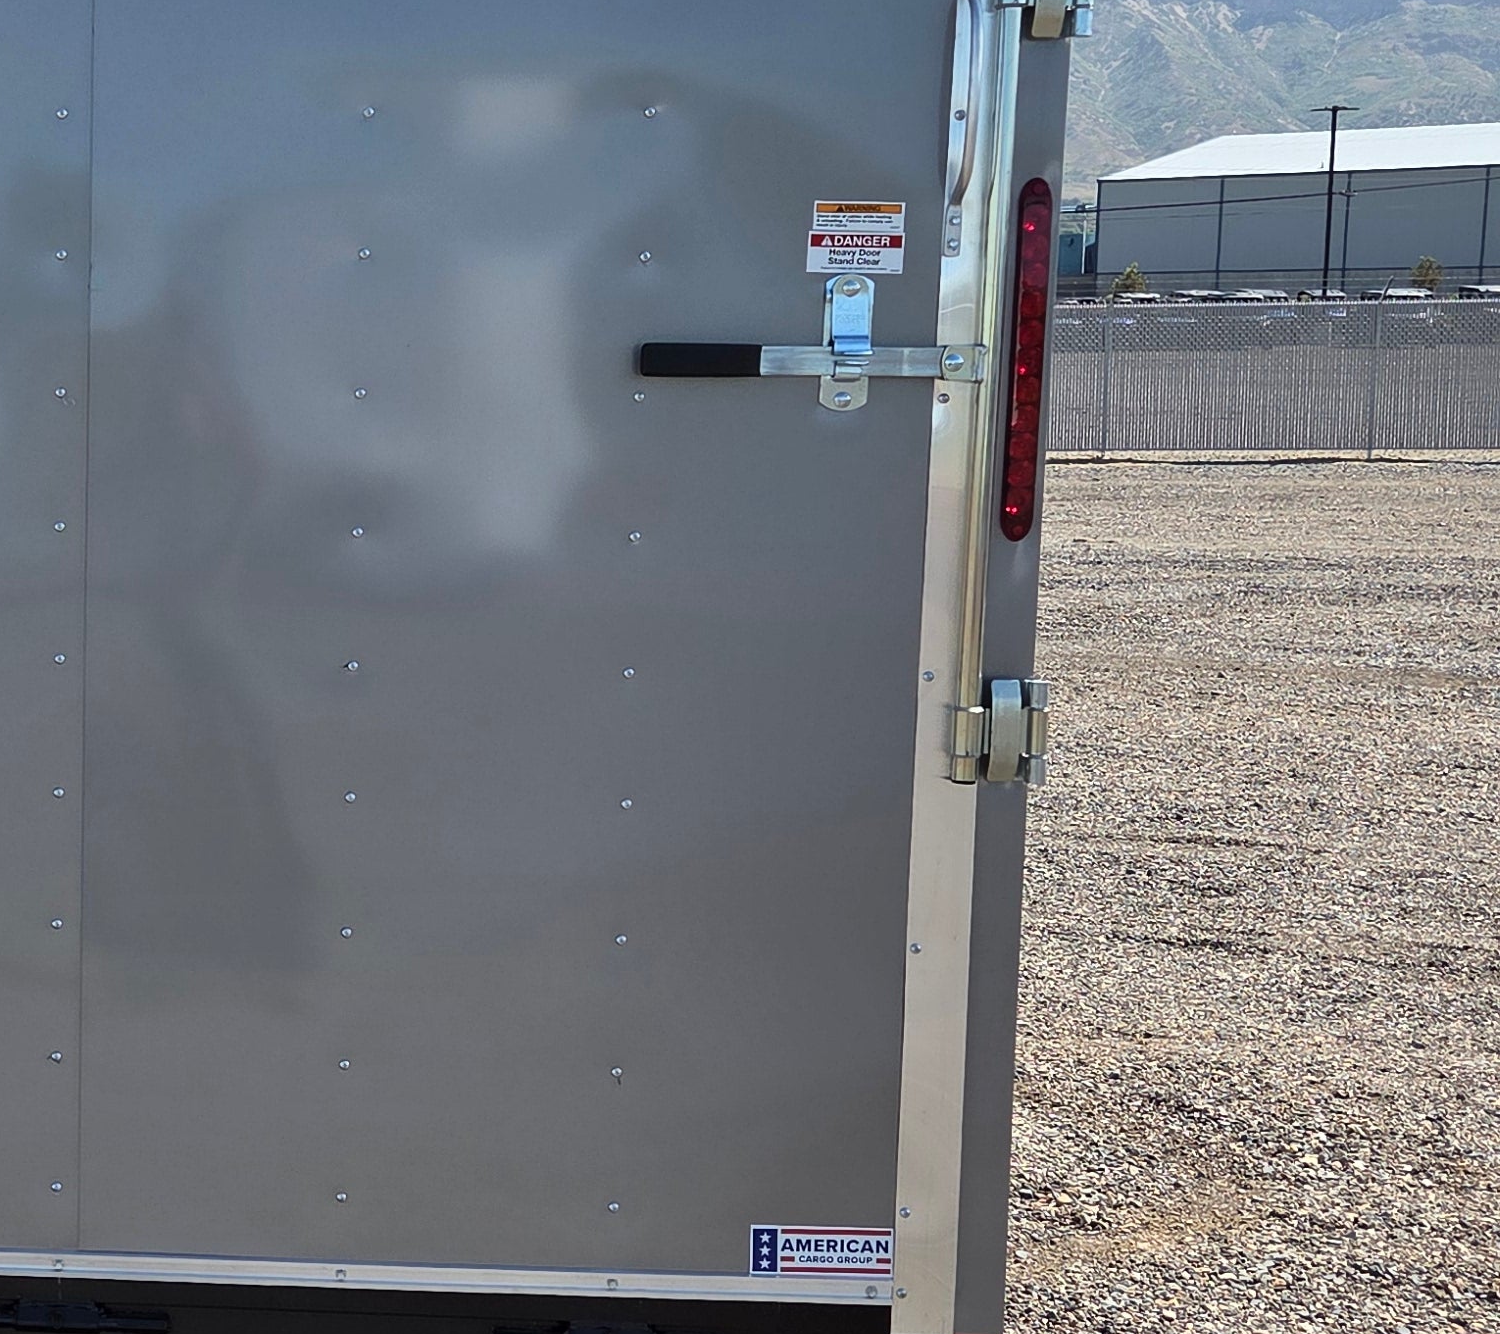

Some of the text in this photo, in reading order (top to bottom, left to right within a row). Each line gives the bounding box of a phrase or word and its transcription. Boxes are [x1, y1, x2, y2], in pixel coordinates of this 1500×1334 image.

[834, 235, 891, 247] DANGER
[829, 249, 881, 257] Heavy Door
[827, 257, 881, 265] Stand Clear
[780, 1238, 889, 1254] AMERICAN
[798, 1255, 873, 1264] CARGO GROUP
